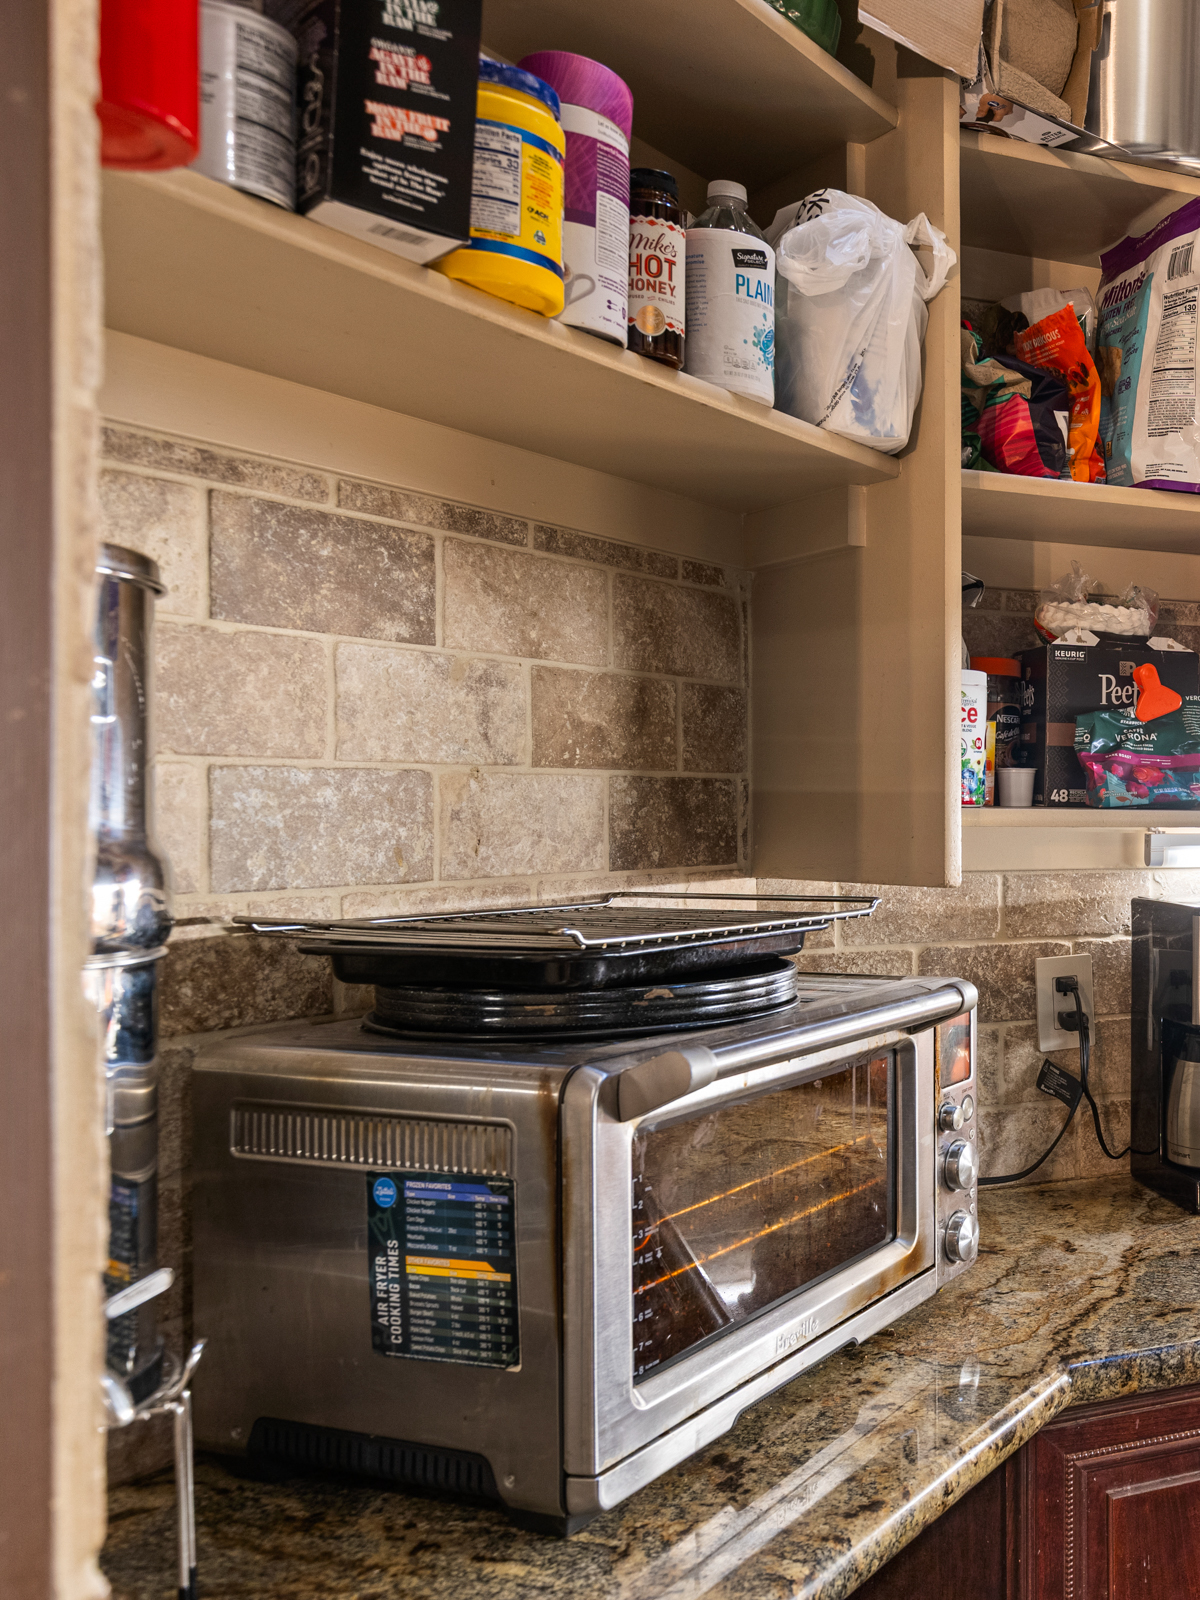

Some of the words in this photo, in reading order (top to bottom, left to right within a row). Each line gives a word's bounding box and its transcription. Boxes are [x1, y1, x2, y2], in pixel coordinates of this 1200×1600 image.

[630, 233, 677, 258] Mike's
[736, 251, 764, 264] Signature
[629, 253, 677, 282] HOT
[629, 278, 676, 297] HONEY
[736, 273, 773, 307] PLAIN
[1101, 270, 1148, 311] Milton's
[1163, 290, 1185, 300] Nutrition
[1186, 286, 1198, 295] Facts
[1184, 303, 1197, 312] 130
[1055, 650, 1085, 658] KEURIG
[1098, 673, 1139, 706] Peet
[1051, 789, 1069, 802] 48
[406, 1181, 425, 1189] FROZEN
[425, 1182, 452, 1191] FAVORITES
[638, 1200, 644, 1209] 2
[638, 1229, 644, 1238] 3
[386, 1239, 400, 1280] TIMES
[638, 1255, 644, 1265] 4
[375, 1256, 388, 1298] FRYER
[377, 1302, 389, 1326] AIR
[388, 1283, 403, 1344] COOKING
[638, 1312, 644, 1321] 6
[776, 1316, 819, 1354] Breville
[638, 1342, 644, 1351] 7
[638, 1366, 644, 1375] 8
